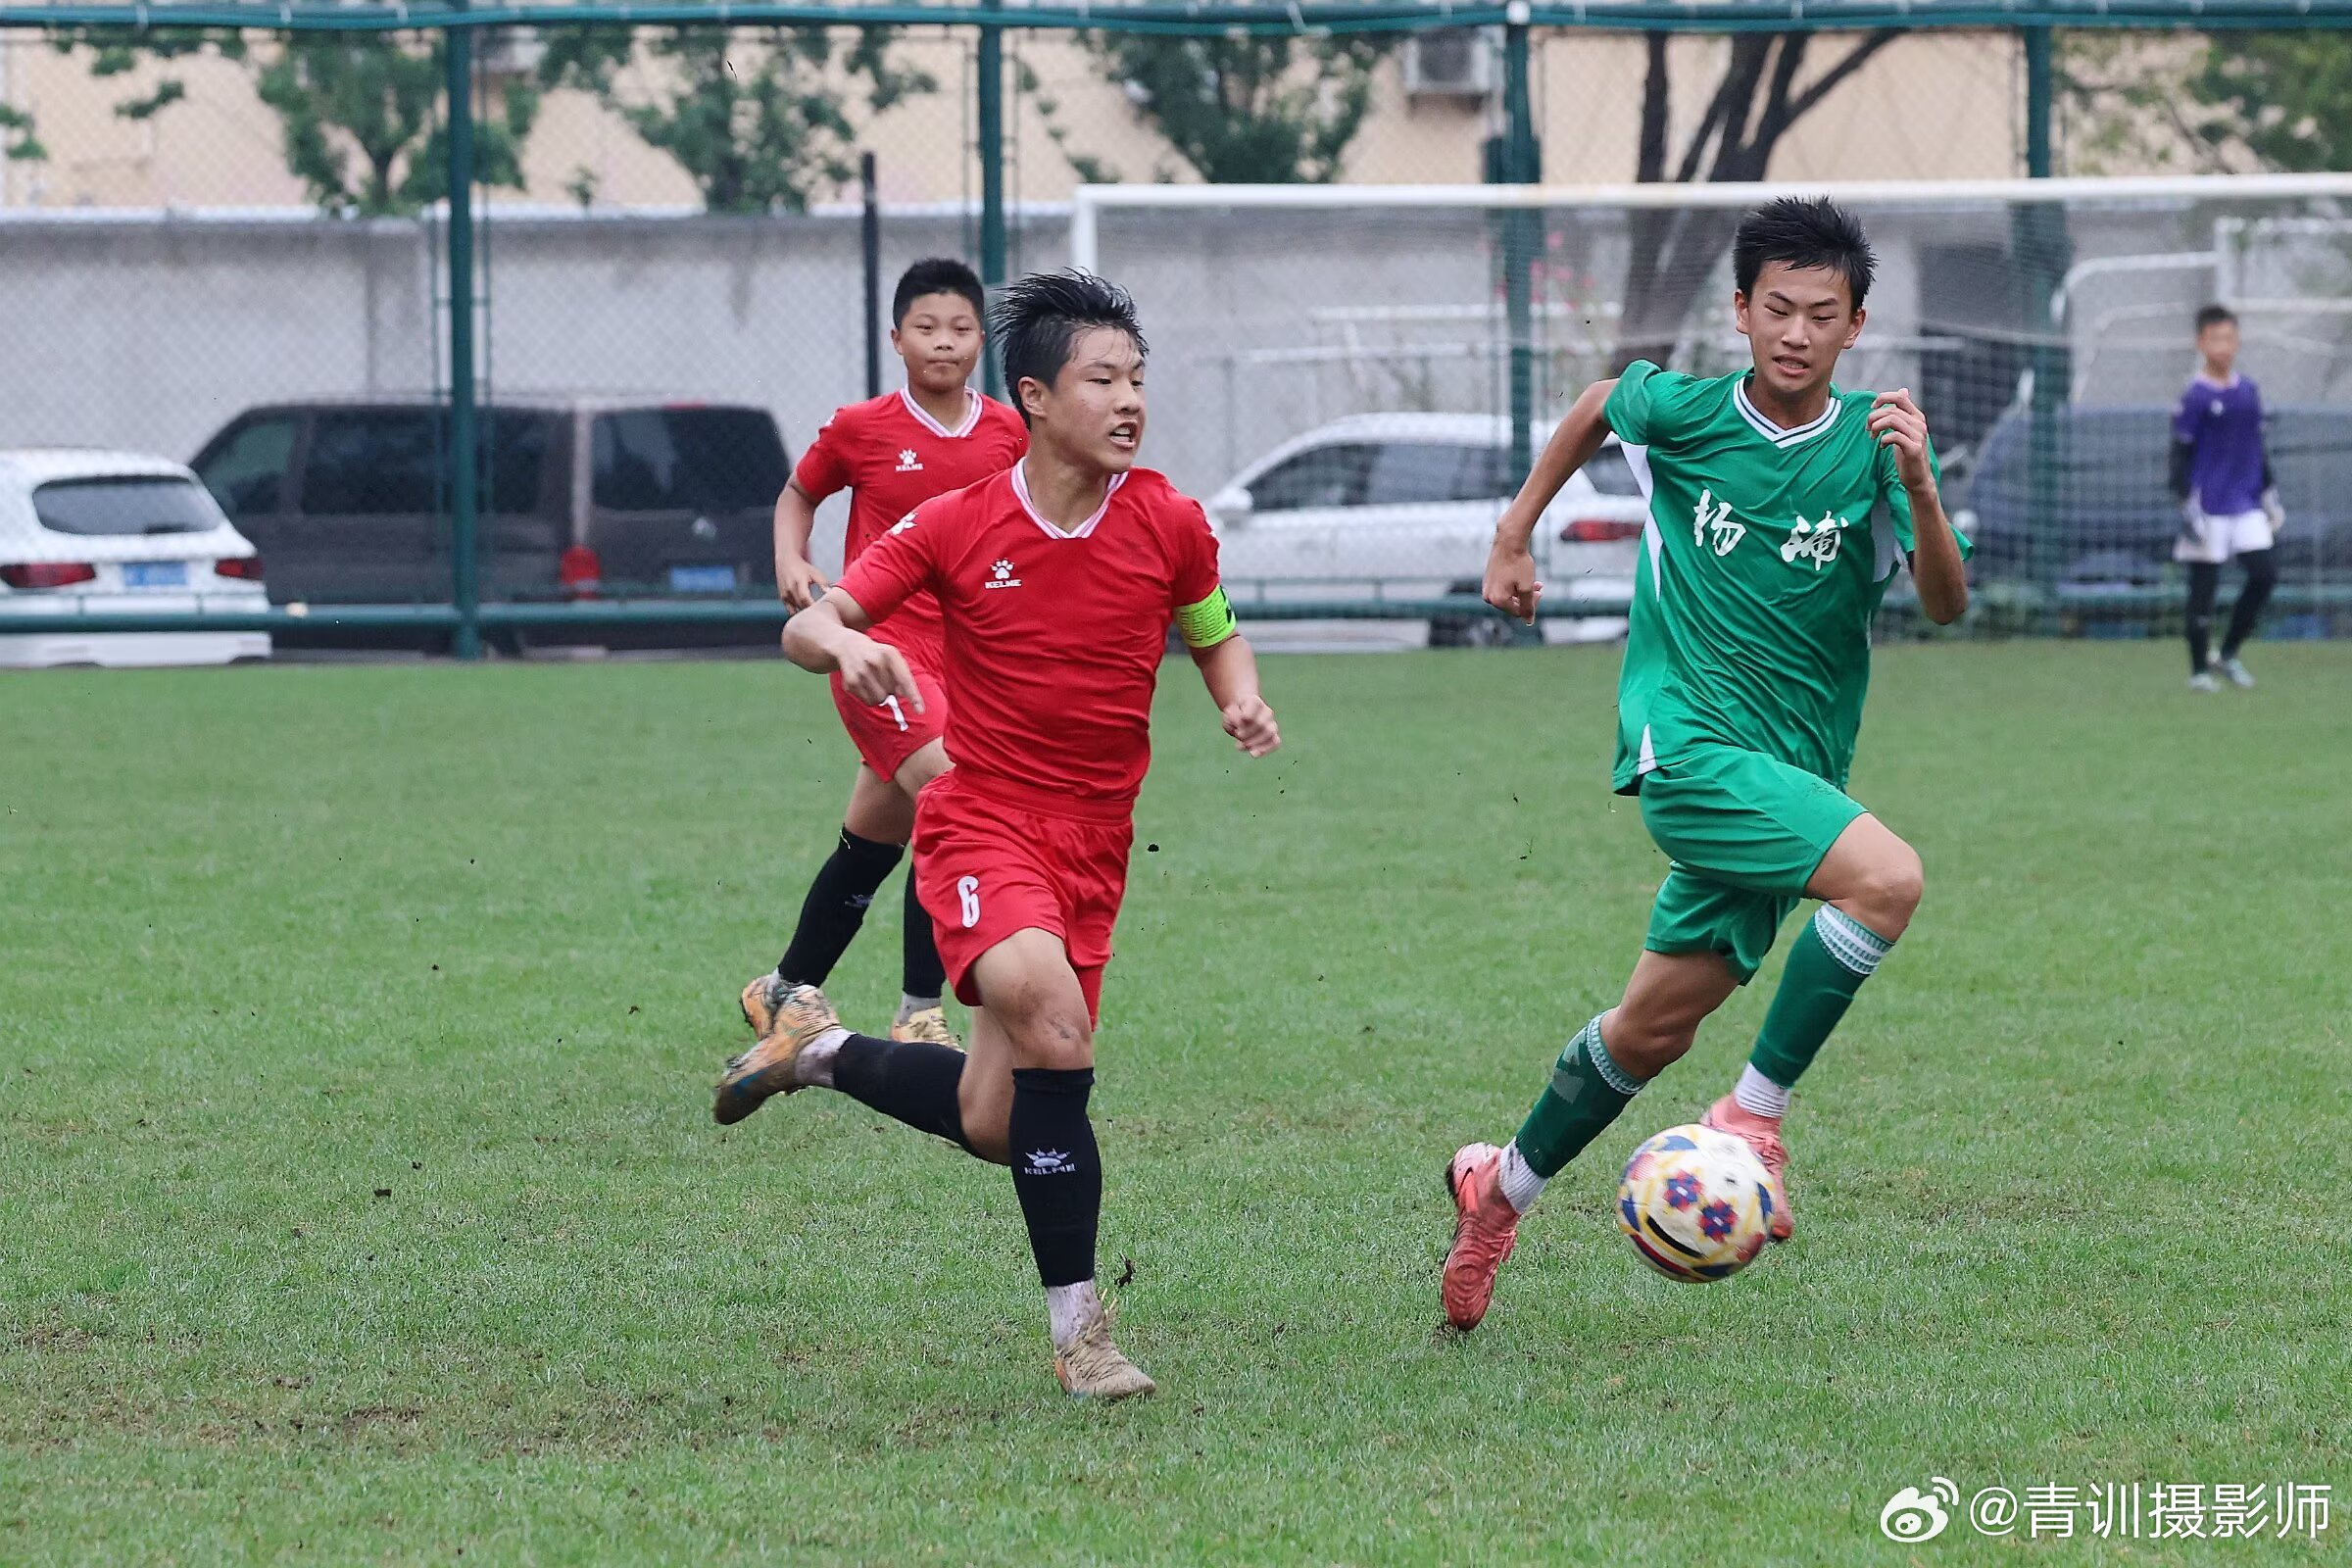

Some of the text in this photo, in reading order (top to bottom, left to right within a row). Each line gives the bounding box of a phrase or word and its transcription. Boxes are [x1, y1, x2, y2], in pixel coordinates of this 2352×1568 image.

[984, 579, 1022, 589] KELME
[956, 875, 982, 929] 6
[1024, 1163, 1076, 1175] KELME
